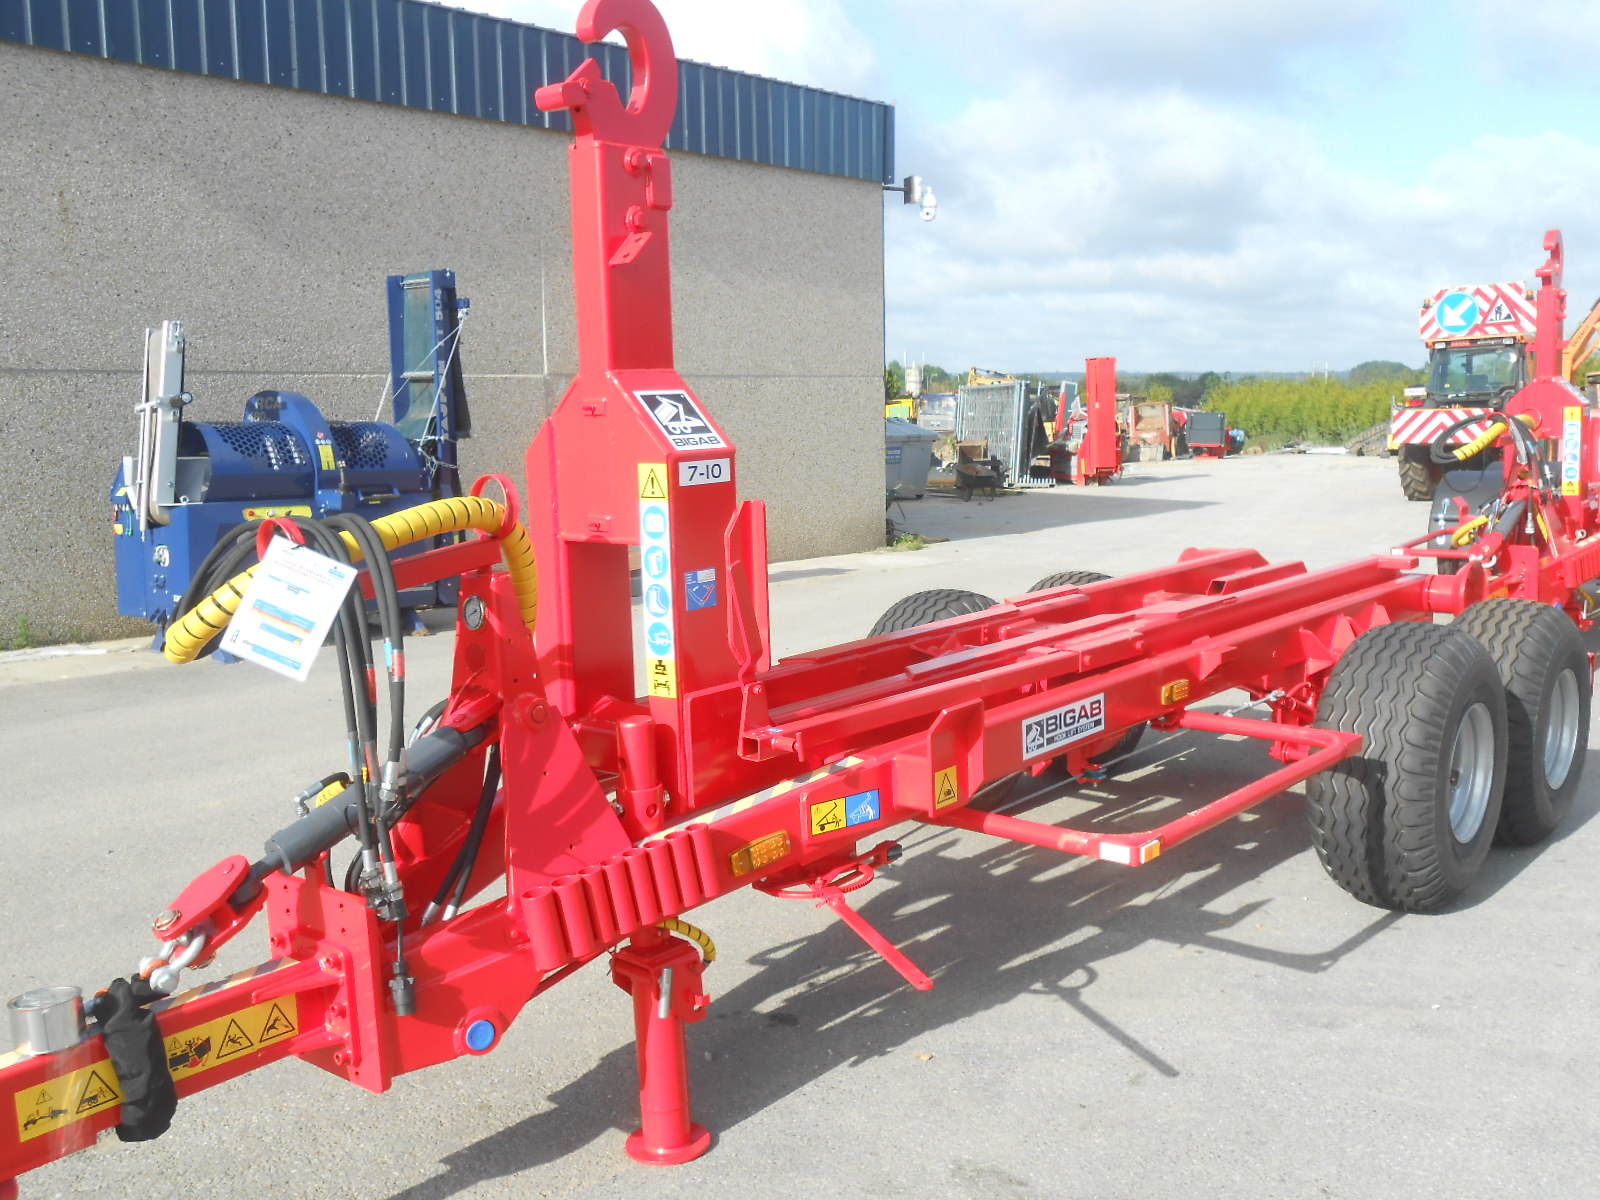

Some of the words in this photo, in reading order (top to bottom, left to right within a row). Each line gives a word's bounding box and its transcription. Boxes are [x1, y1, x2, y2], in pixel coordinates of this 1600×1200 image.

[434, 288, 443, 320] 504
[673, 436, 720, 447] BIGAB
[688, 464, 722, 481] 7-10
[1046, 699, 1101, 735] BIGAB
